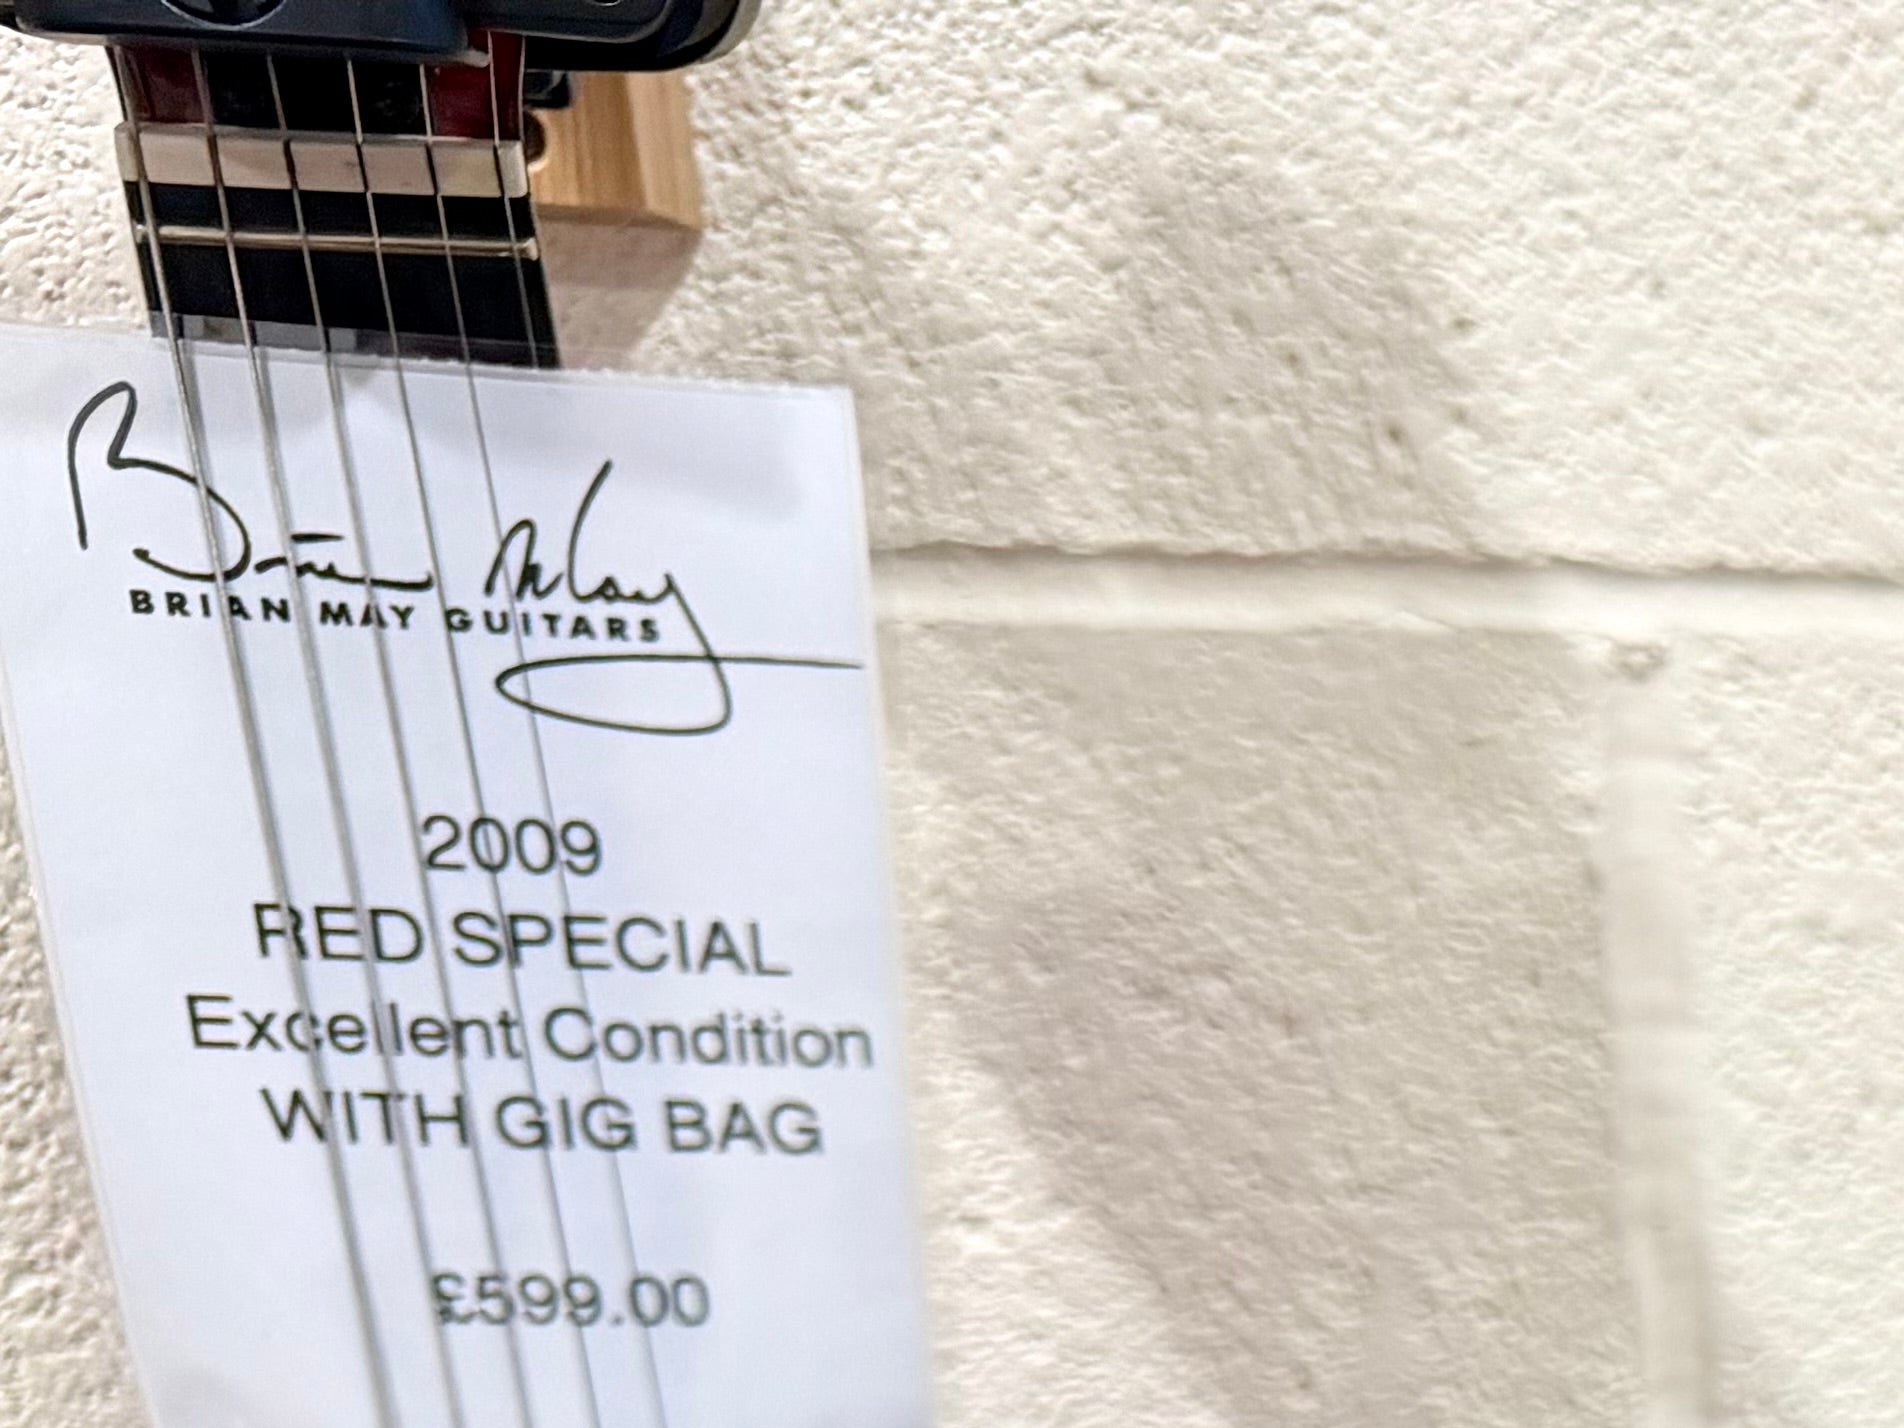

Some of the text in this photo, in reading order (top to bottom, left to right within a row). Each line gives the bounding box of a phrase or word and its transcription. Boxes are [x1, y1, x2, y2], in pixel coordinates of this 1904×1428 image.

[129, 588, 661, 643] BRIAN MAY GUITARS
[421, 814, 602, 876] 2009
[253, 902, 793, 977] RED SPECIAL
[185, 993, 875, 1070] Excellent Condition
[260, 1087, 825, 1157] WITH GIG BAG
[430, 1271, 712, 1329] £599.00
